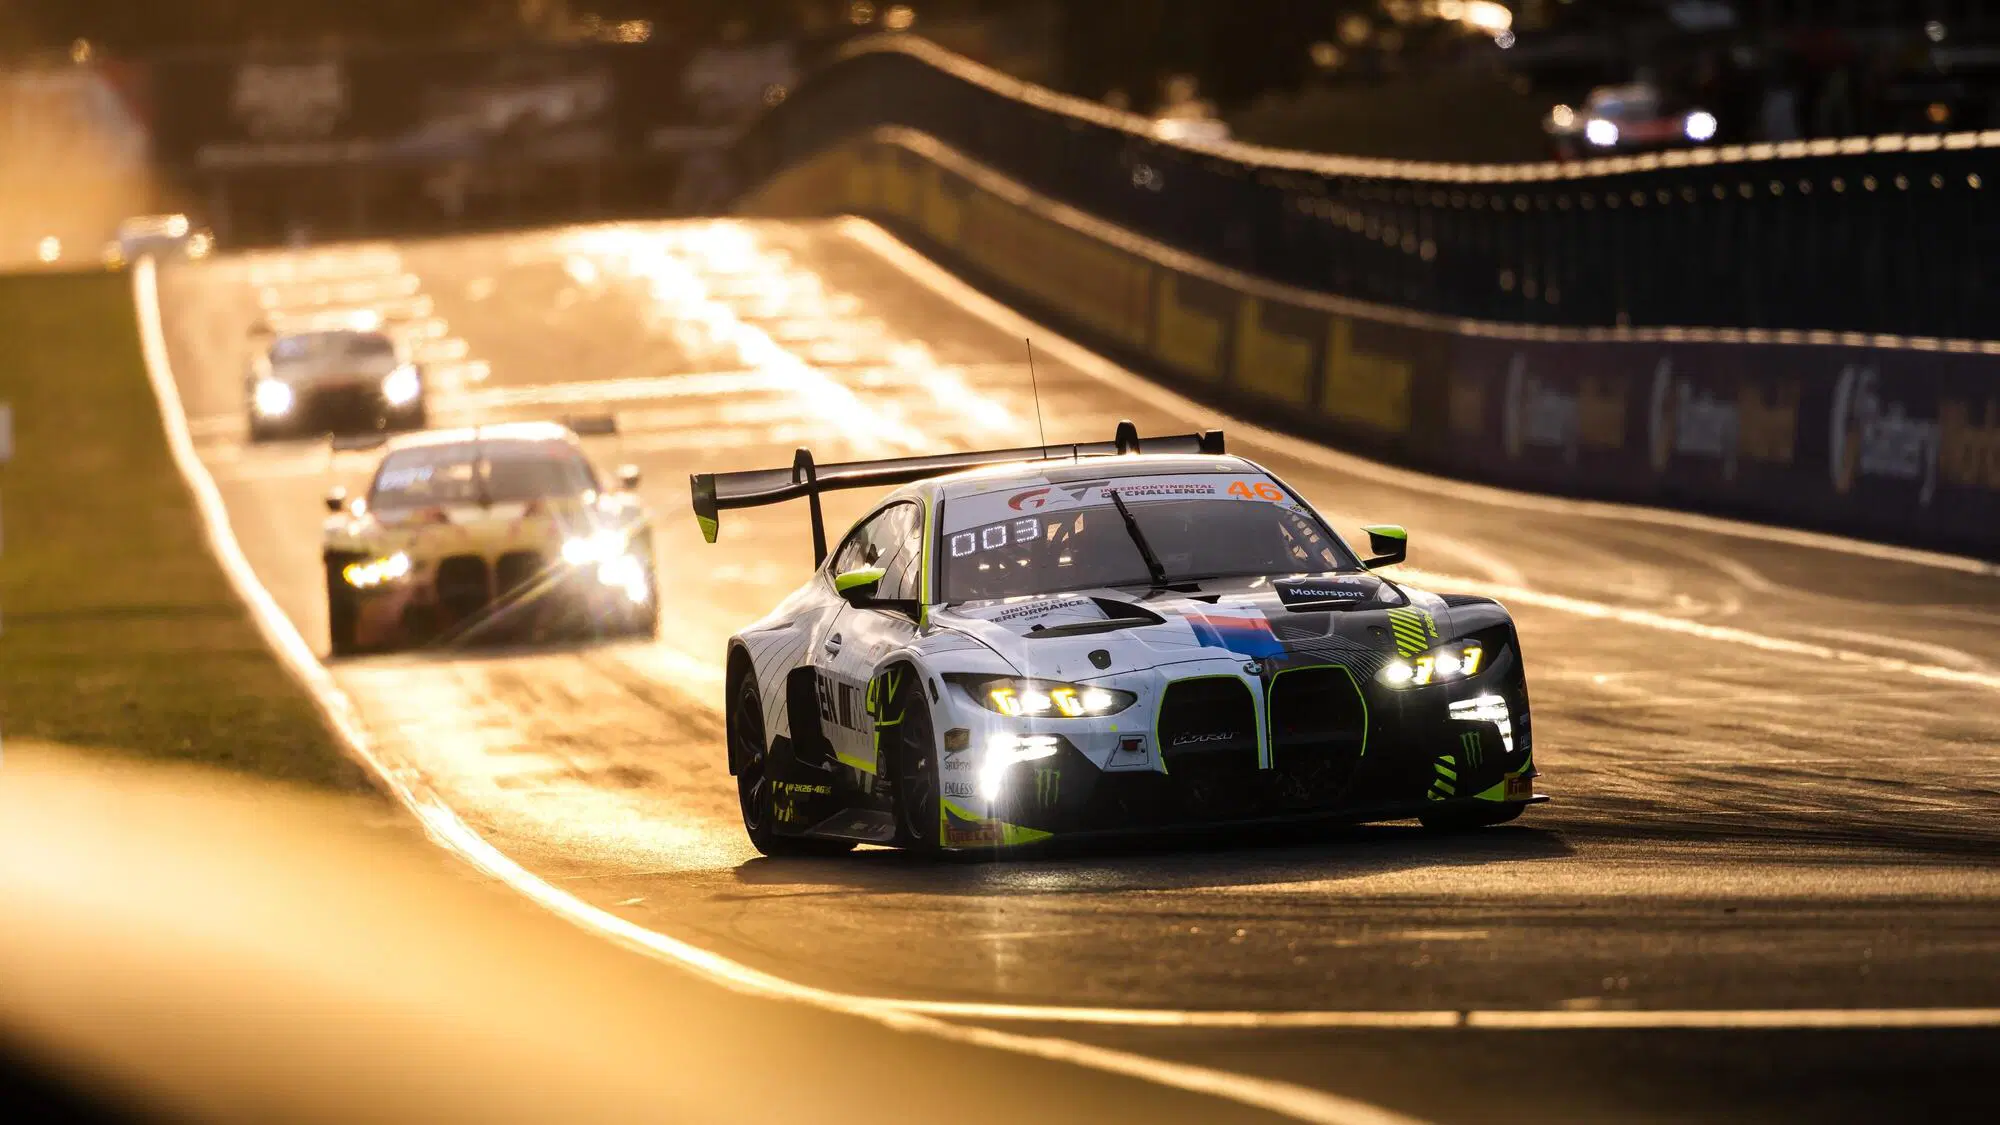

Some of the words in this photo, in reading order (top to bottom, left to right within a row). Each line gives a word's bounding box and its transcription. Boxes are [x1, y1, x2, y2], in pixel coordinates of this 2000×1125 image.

[1100, 484, 1214, 494] INTERCONTINENTAL
[1124, 488, 1216, 497] CHALLENGE
[1228, 481, 1284, 501] 46
[951, 518, 1038, 557] 003
[1288, 588, 1365, 598] Motorsport
[1000, 601, 1049, 616] UNITED
[944, 781, 974, 795] ENDLESS
